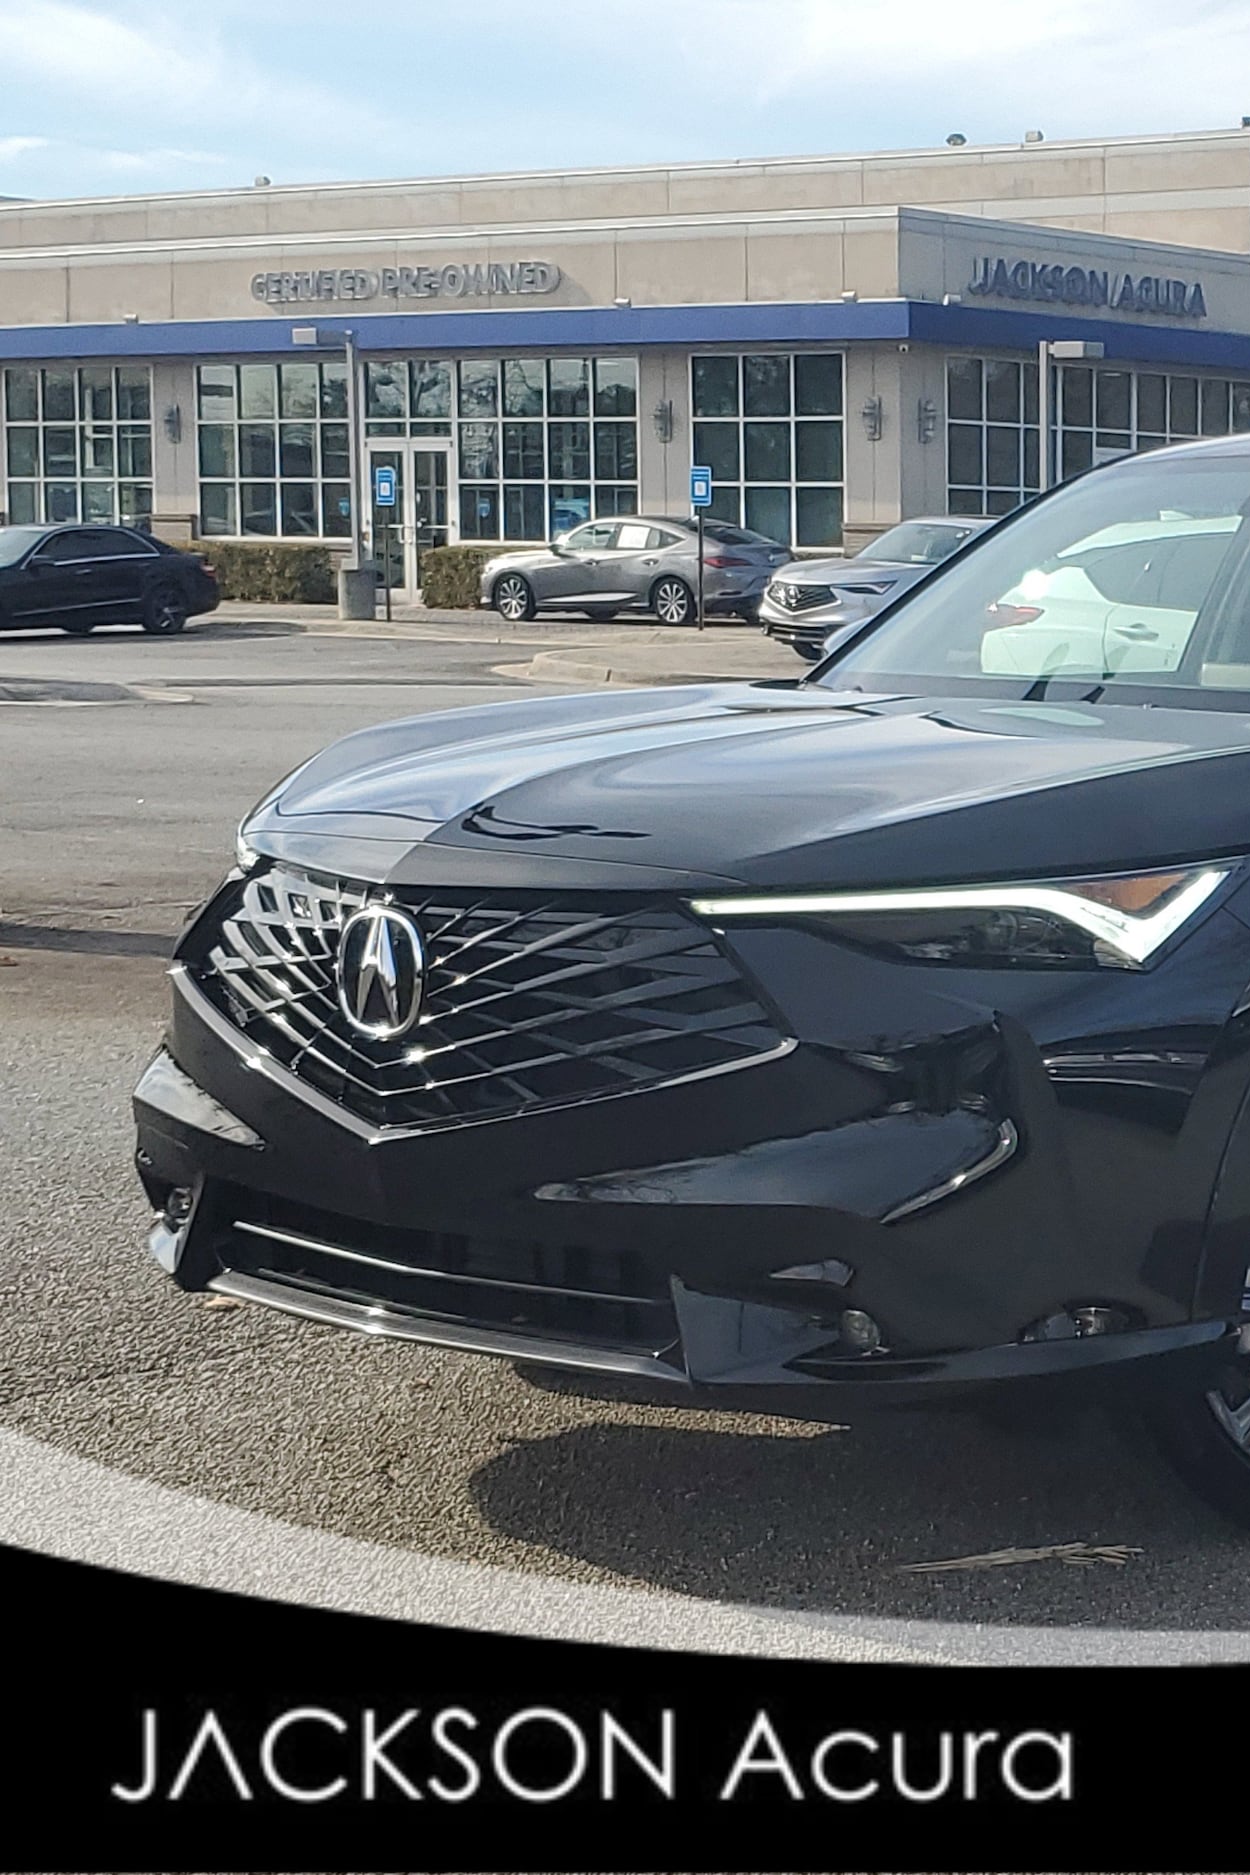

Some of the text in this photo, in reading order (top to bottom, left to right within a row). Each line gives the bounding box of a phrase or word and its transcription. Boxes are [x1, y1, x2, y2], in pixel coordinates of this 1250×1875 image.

[251, 261, 561, 303] CERTIFIED PRE-OWNED
[968, 257, 1208, 318] JACKSON ACURA
